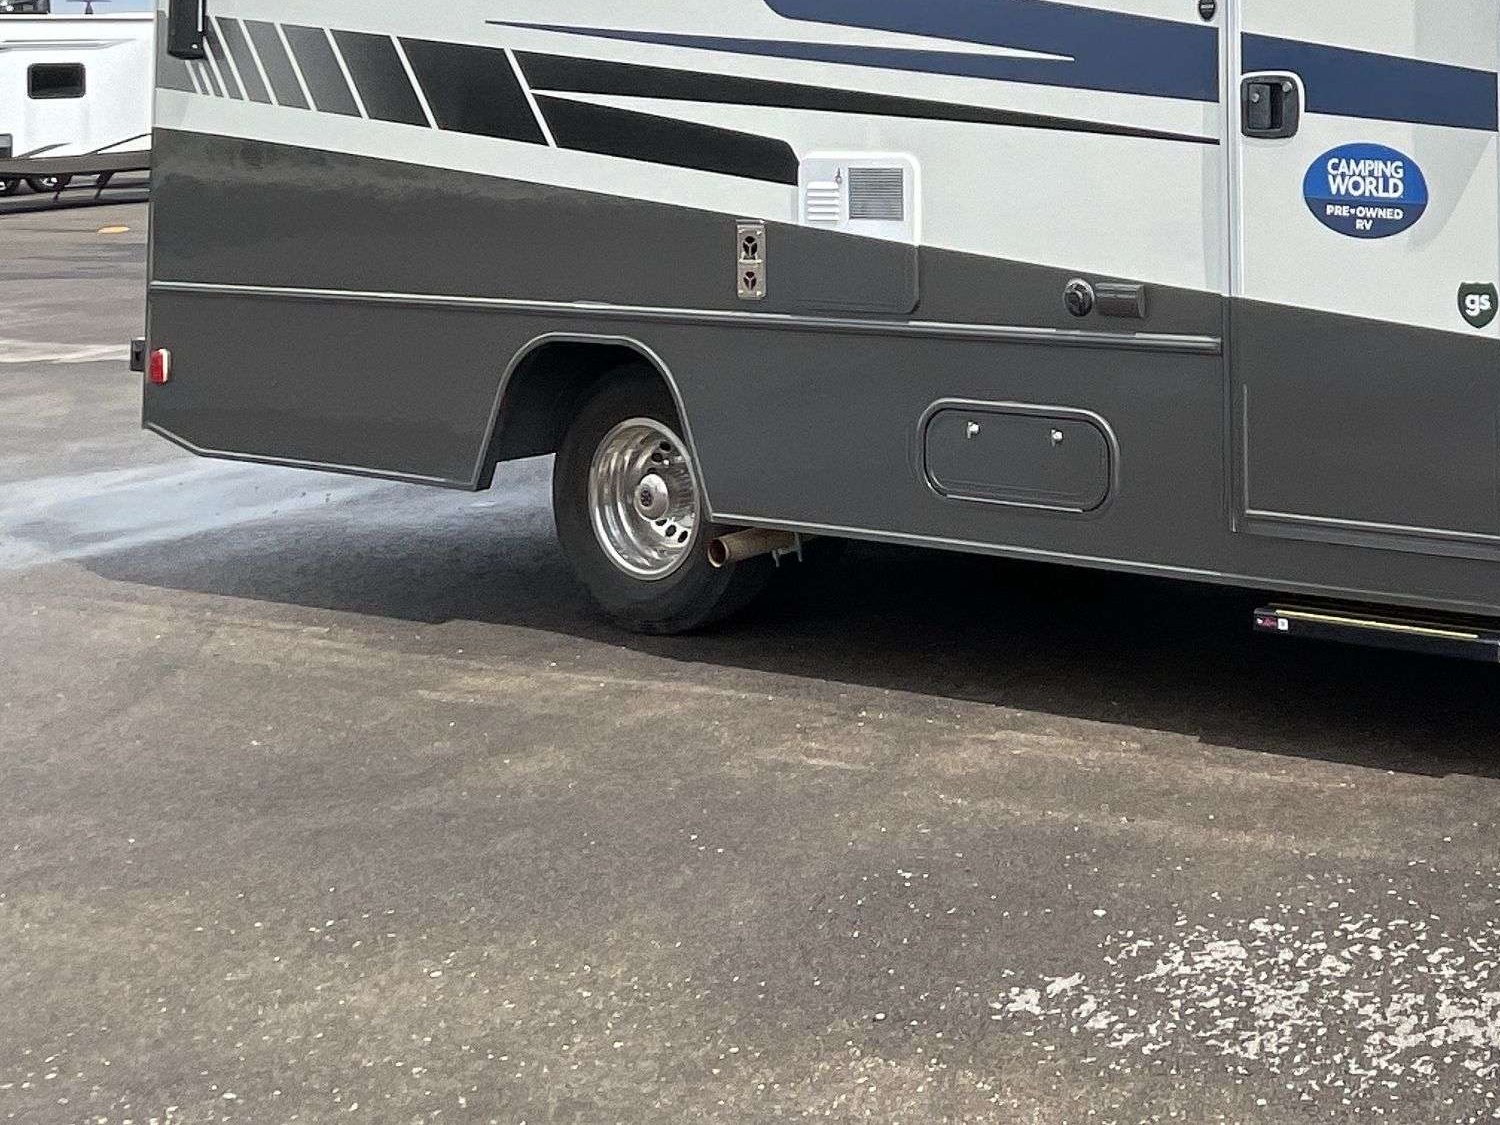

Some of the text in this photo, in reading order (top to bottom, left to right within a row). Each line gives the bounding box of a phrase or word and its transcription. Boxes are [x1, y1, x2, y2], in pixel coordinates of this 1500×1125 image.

[1327, 158, 1404, 178] CAMPING
[1327, 175, 1404, 198] WORLD
[1355, 219, 1373, 230] RV
[1465, 294, 1491, 317] gs
